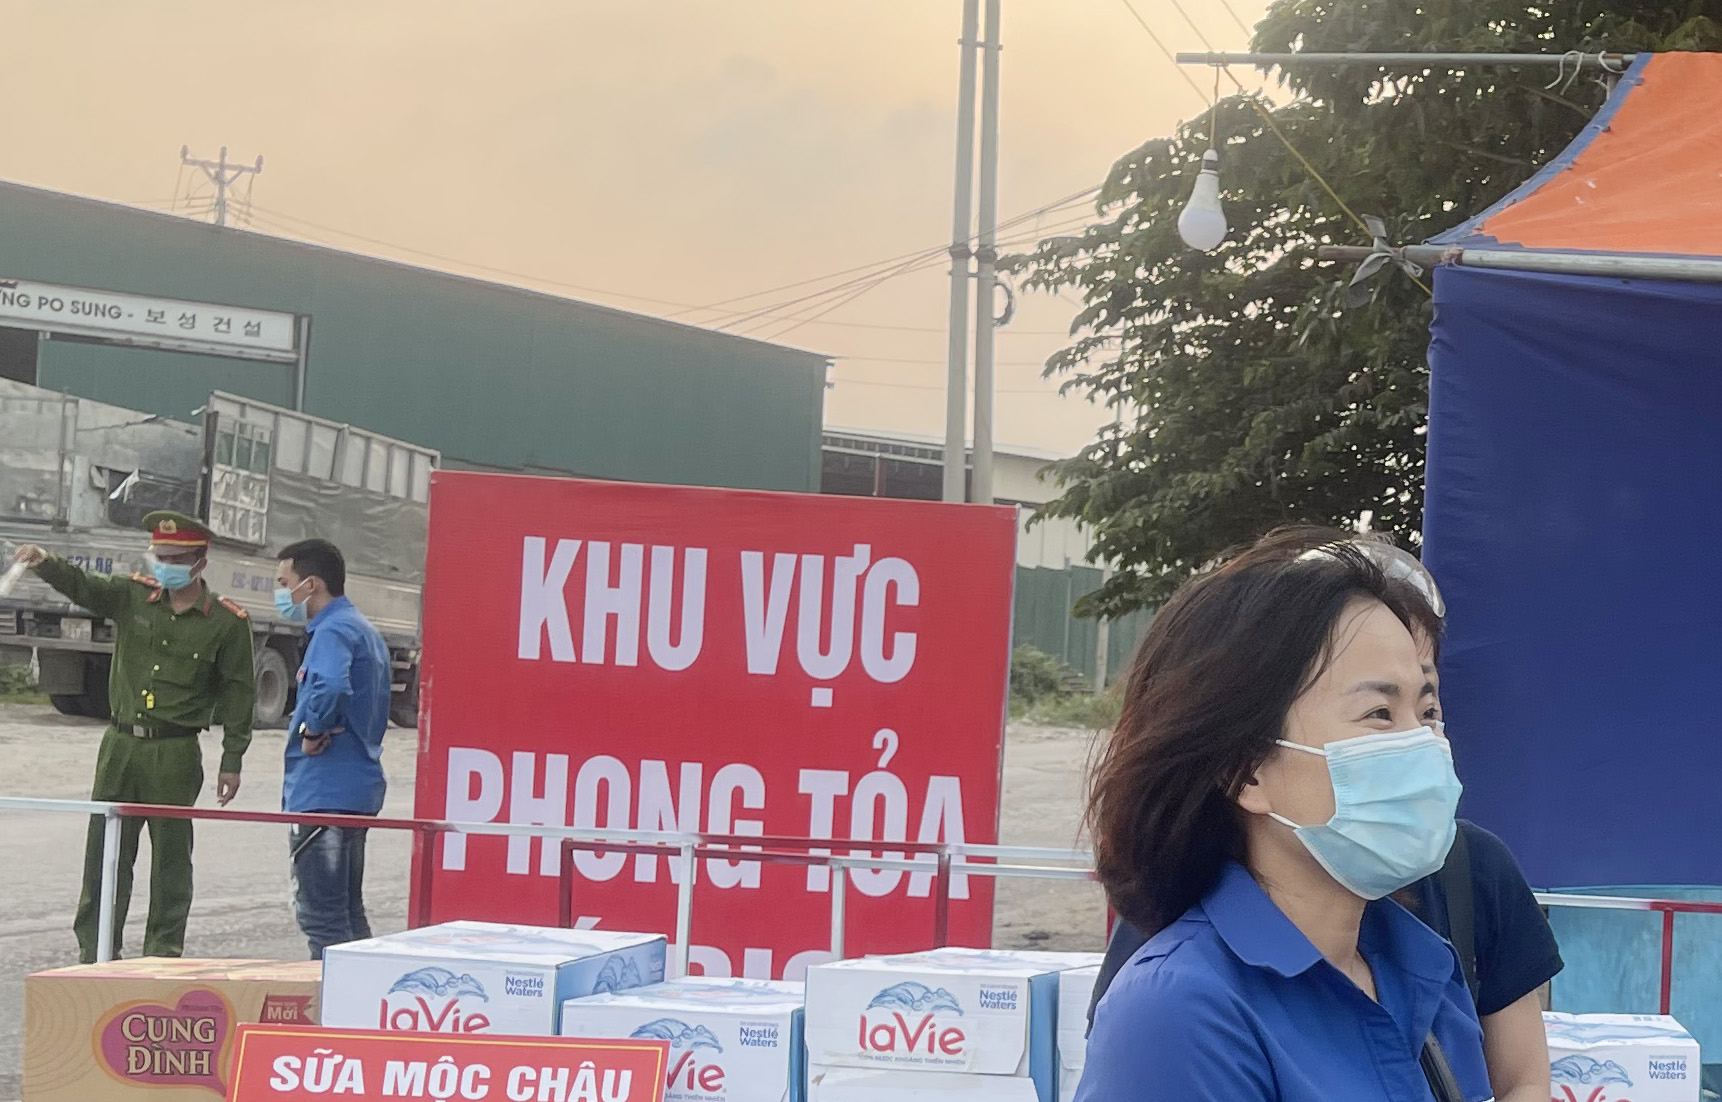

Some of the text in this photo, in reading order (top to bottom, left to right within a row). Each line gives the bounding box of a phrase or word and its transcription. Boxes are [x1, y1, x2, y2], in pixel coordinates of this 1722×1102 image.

[38, 296, 64, 313] PO
[71, 301, 122, 320] SUNG
[517, 536, 920, 708] KHU VỰC
[442, 727, 971, 900] PHONG TỎA
[506, 976, 544, 988] Nestlé
[506, 986, 543, 998] Waters
[979, 988, 1017, 1001] Nestlé
[979, 999, 1017, 1010] Waters
[121, 1013, 216, 1045] CUNG
[740, 1027, 779, 1039] Nestlé
[859, 1012, 965, 1055] laVie
[740, 1037, 778, 1048] Waters
[126, 1044, 213, 1076] ĐÌNH
[1648, 1059, 1687, 1072] Nestlé
[269, 1048, 365, 1095] SỮA
[1648, 1070, 1687, 1080] Waters
